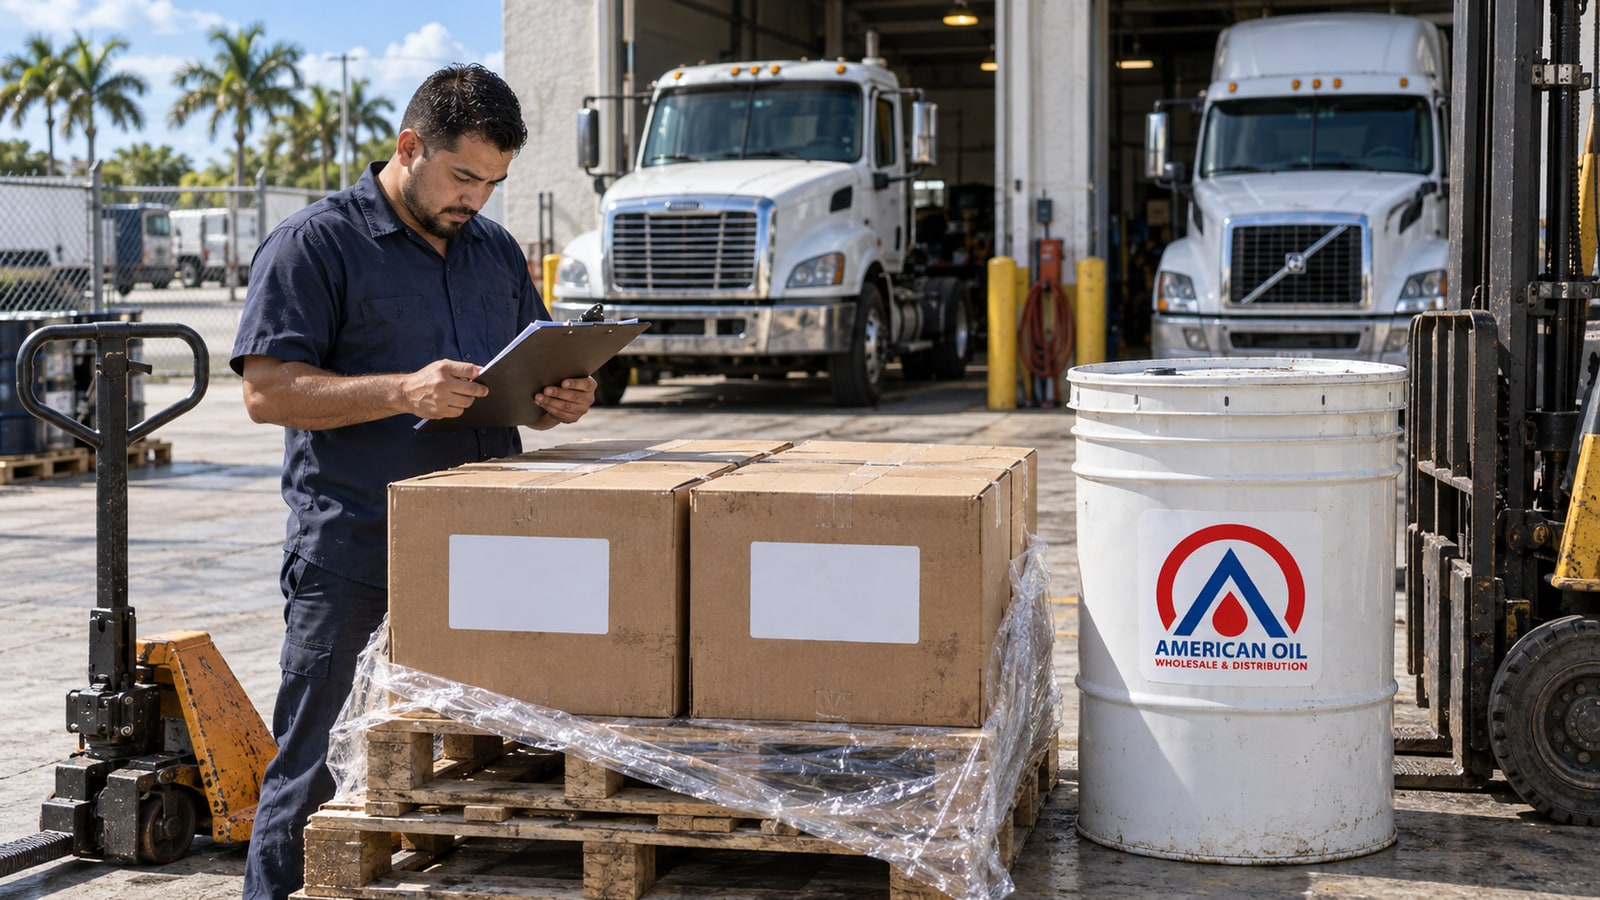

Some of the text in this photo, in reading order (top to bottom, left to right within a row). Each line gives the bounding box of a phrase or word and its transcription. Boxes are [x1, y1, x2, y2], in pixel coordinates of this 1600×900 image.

[1155, 640, 1307, 659] AMERICAN OIL
[1155, 659, 1308, 671] WHOLESALE & DISTRIBUTION
